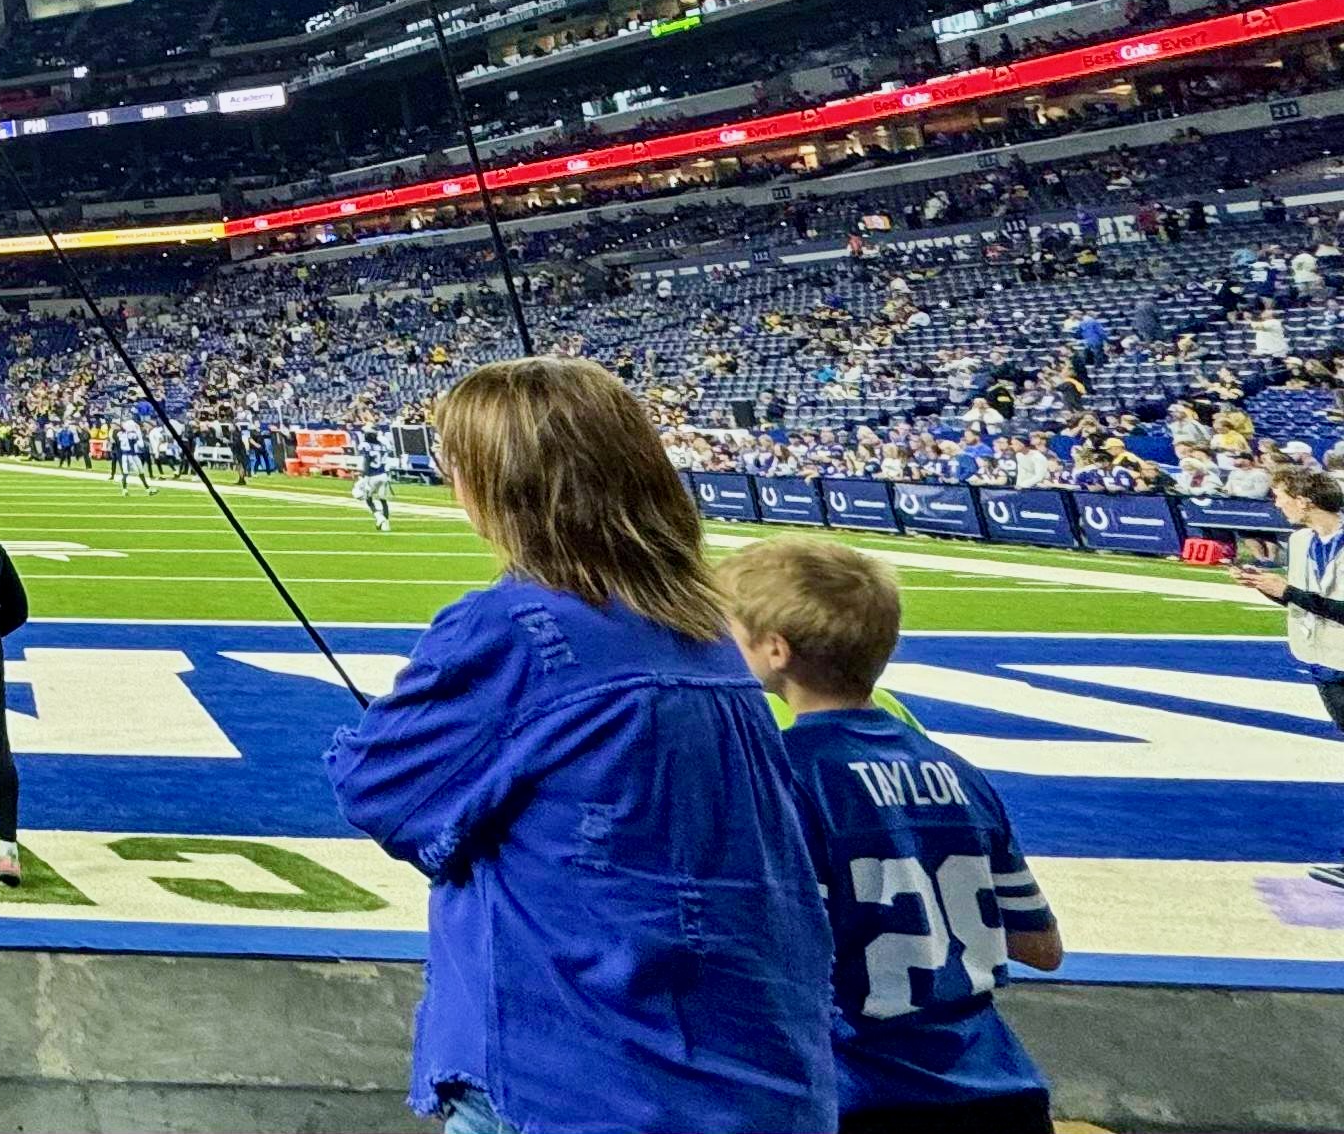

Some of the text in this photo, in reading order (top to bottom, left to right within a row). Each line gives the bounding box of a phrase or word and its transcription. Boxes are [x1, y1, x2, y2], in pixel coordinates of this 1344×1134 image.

[1083, 30, 1209, 68] Best Coke Ever?
[874, 82, 968, 113] Best Coke Ever?
[1189, 542, 1209, 561] 10
[849, 761, 972, 808] TAYLOR
